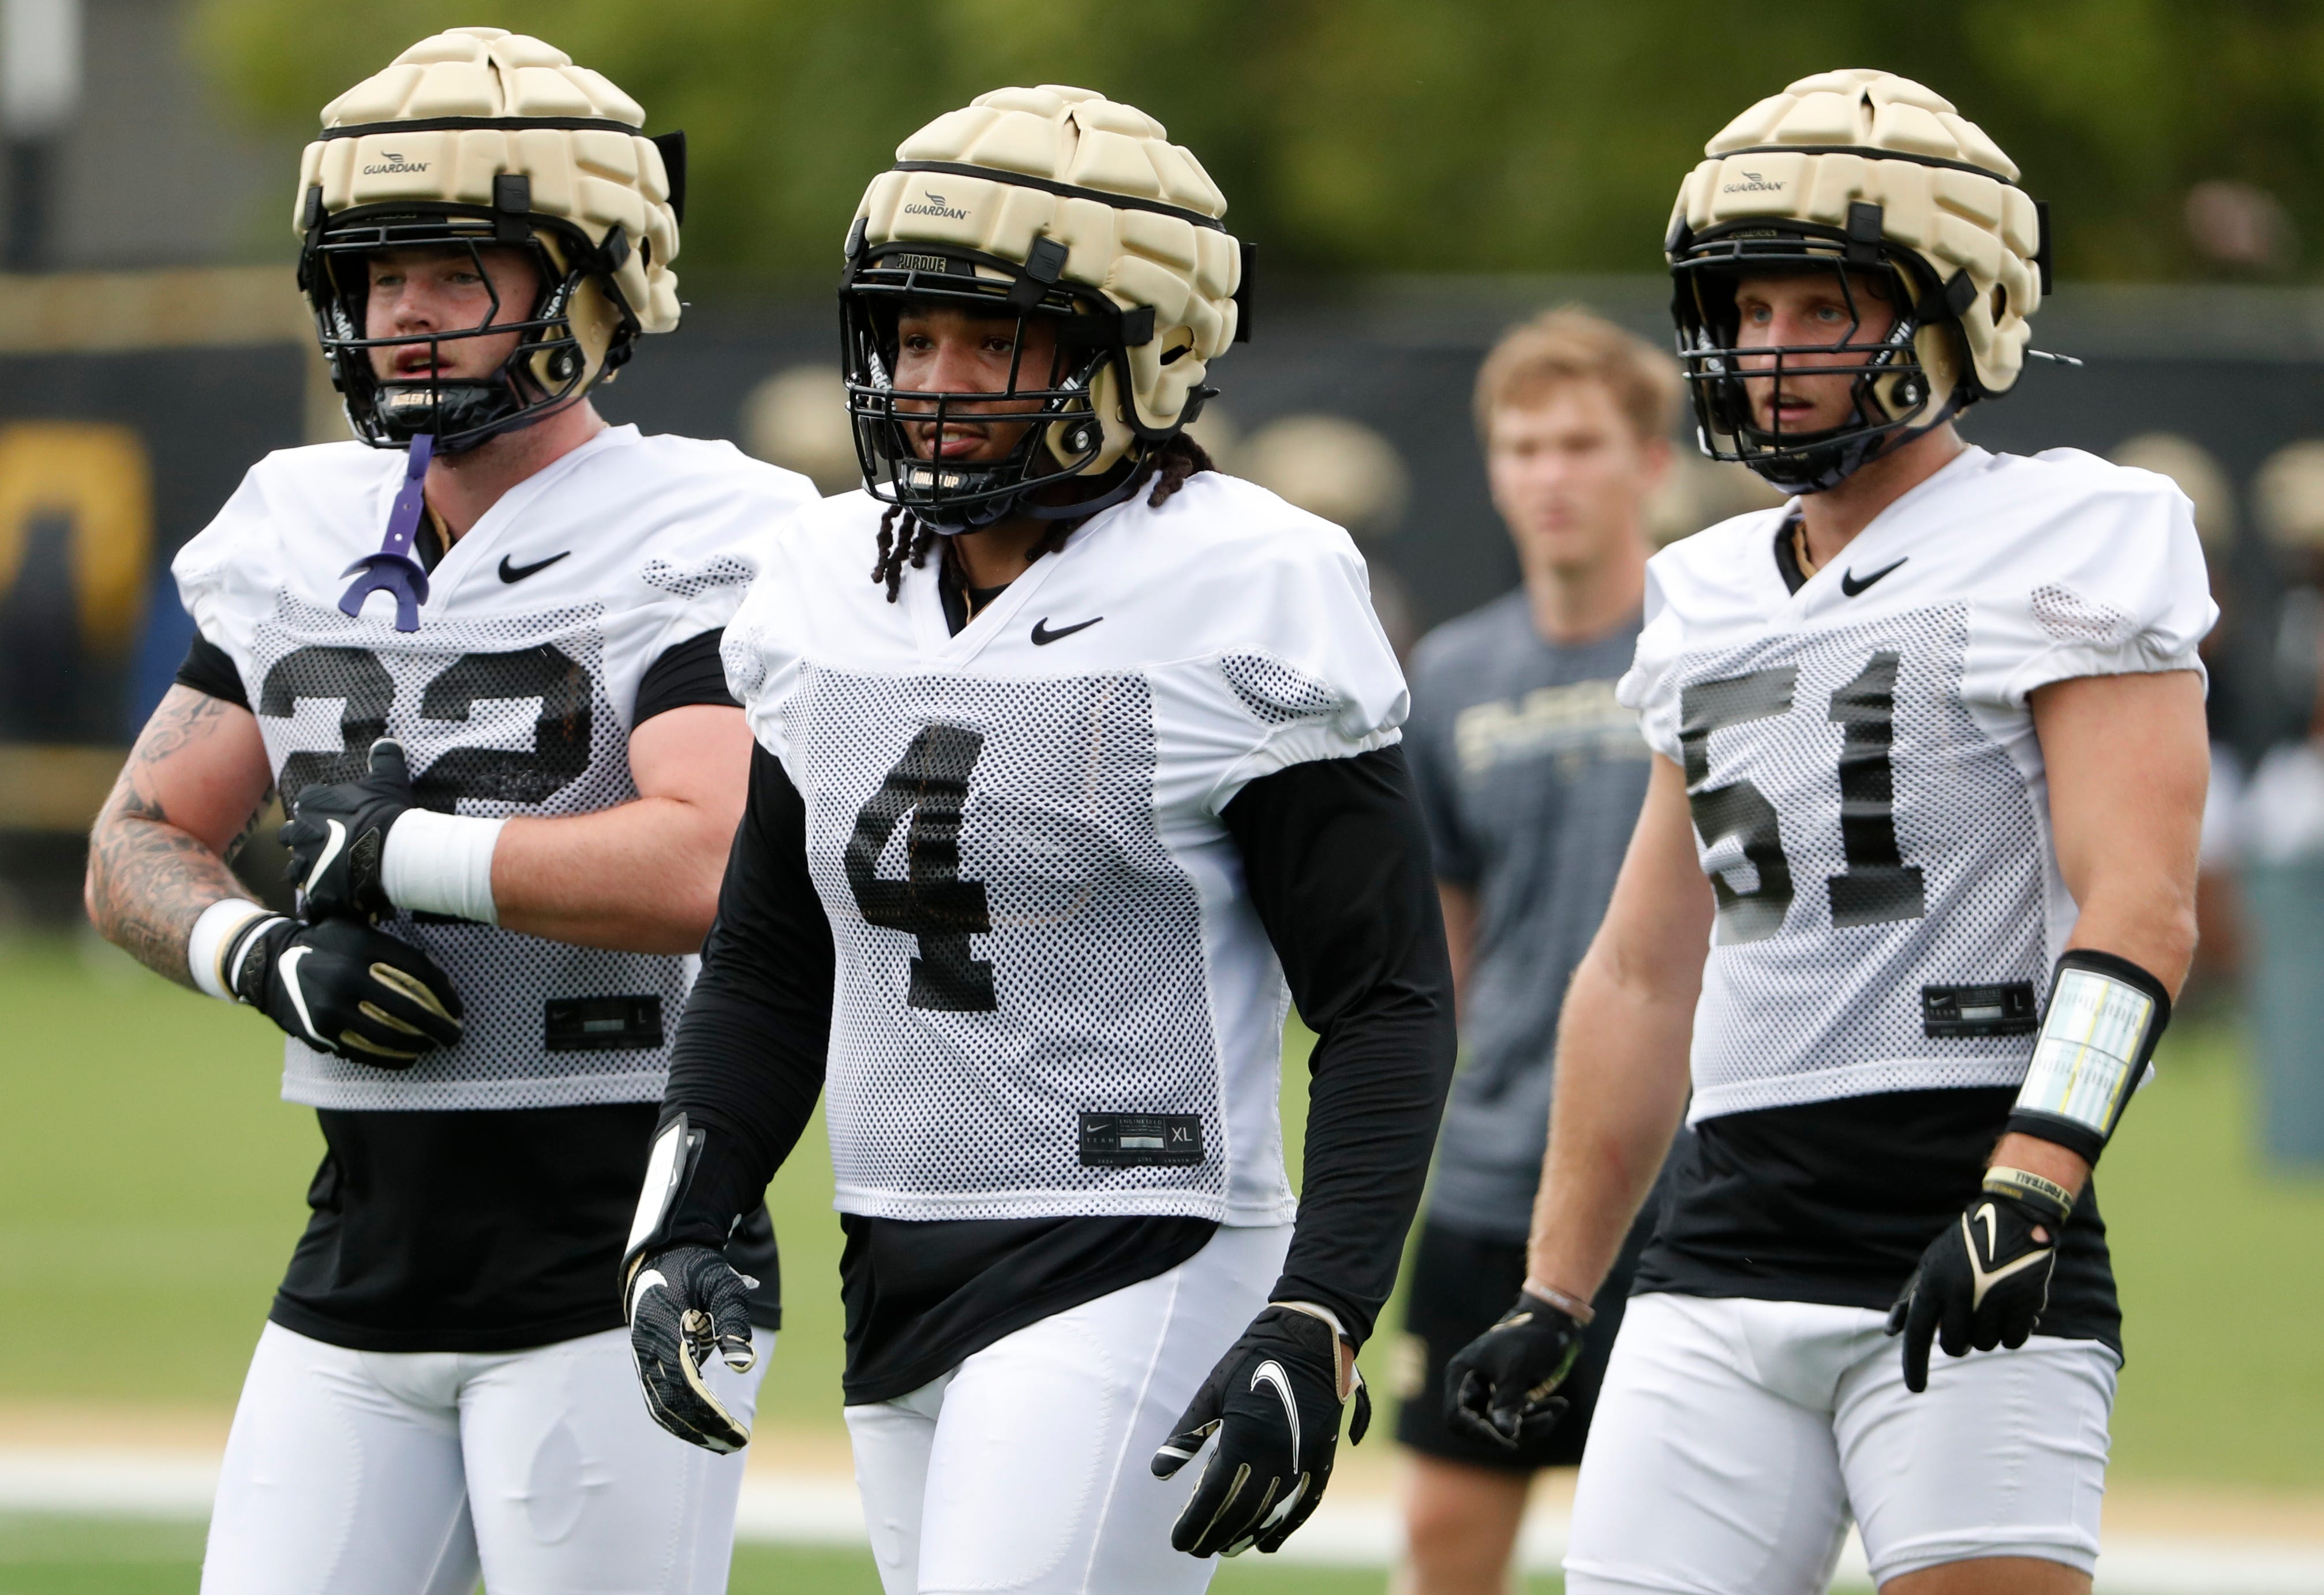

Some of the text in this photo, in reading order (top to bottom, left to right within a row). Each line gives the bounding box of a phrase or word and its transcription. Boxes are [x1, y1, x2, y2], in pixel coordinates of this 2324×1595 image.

[364, 162, 428, 175] GUARDIAN
[1723, 181, 1783, 193] GUARDIAN
[904, 203, 967, 220] GUARDIAN
[896, 253, 946, 272] PURDUE
[944, 475, 959, 488] UP
[1678, 650, 1925, 947] 51
[843, 722, 1000, 1012] 4
[1171, 1126, 1193, 1142] XL
